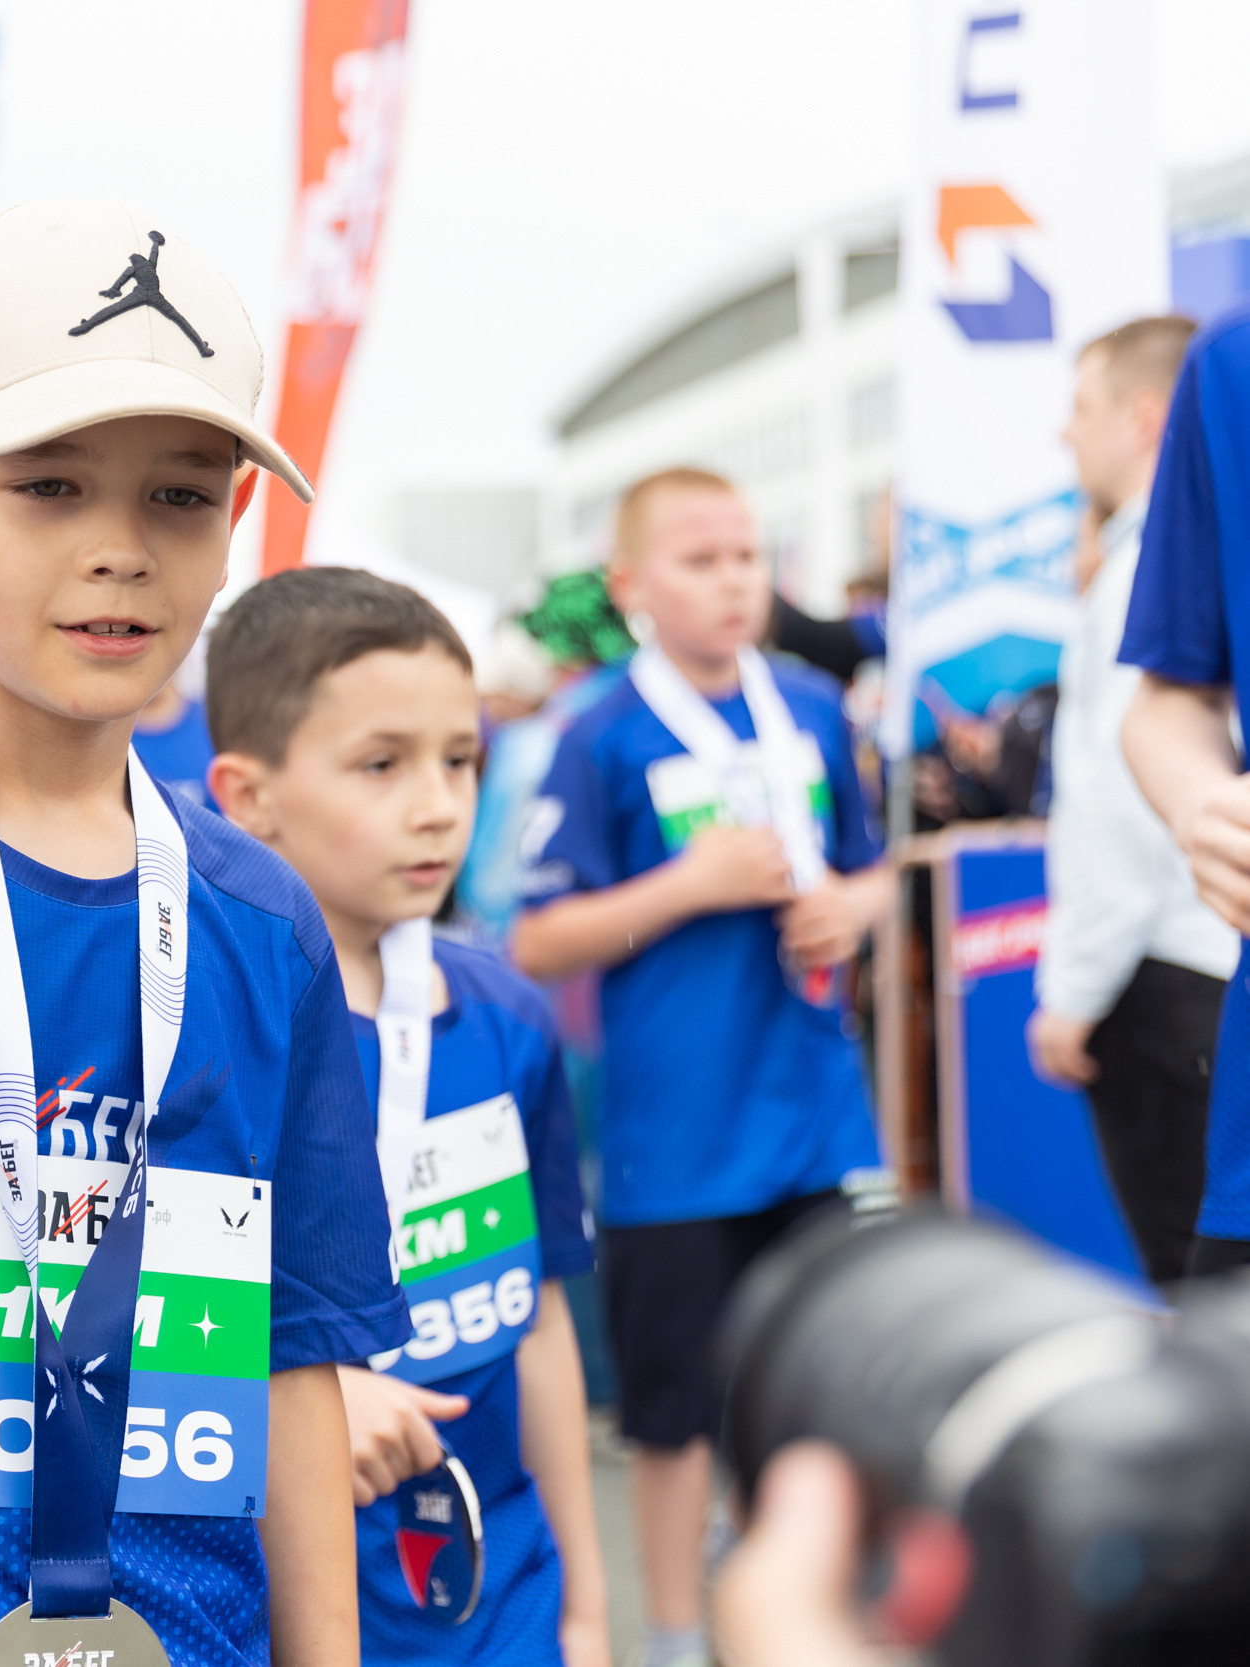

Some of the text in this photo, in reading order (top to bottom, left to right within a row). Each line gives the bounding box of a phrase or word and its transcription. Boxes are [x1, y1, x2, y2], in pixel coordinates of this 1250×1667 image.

[158, 902, 172, 962] ЗА БЕГ
[0, 1139, 23, 1202] ЗА БЕГ
[122, 1135, 144, 1219] ПСБ
